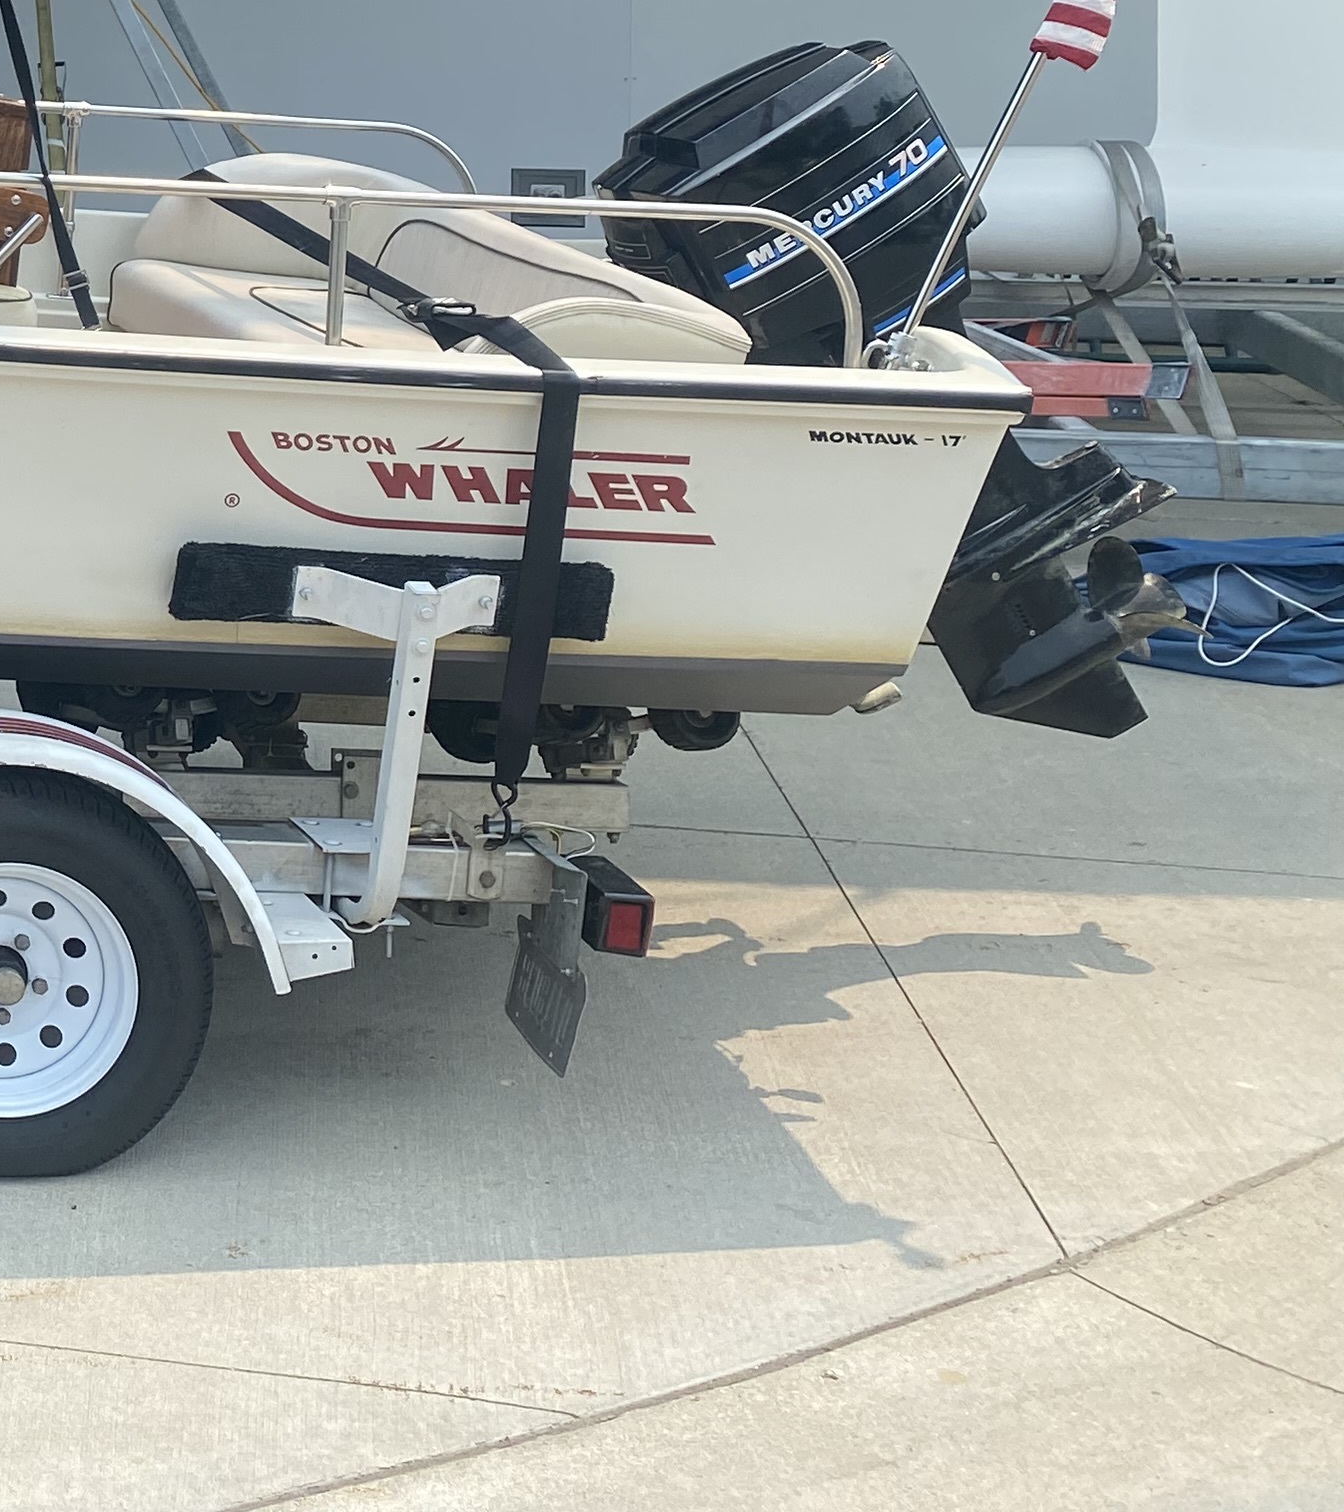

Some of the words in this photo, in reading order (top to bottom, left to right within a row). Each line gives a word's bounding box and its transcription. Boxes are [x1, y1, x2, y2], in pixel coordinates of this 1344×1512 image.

[745, 170, 888, 269] MECURY
[888, 137, 930, 177] 70
[270, 431, 397, 455] BOSTON
[809, 430, 918, 445] MONTAUK
